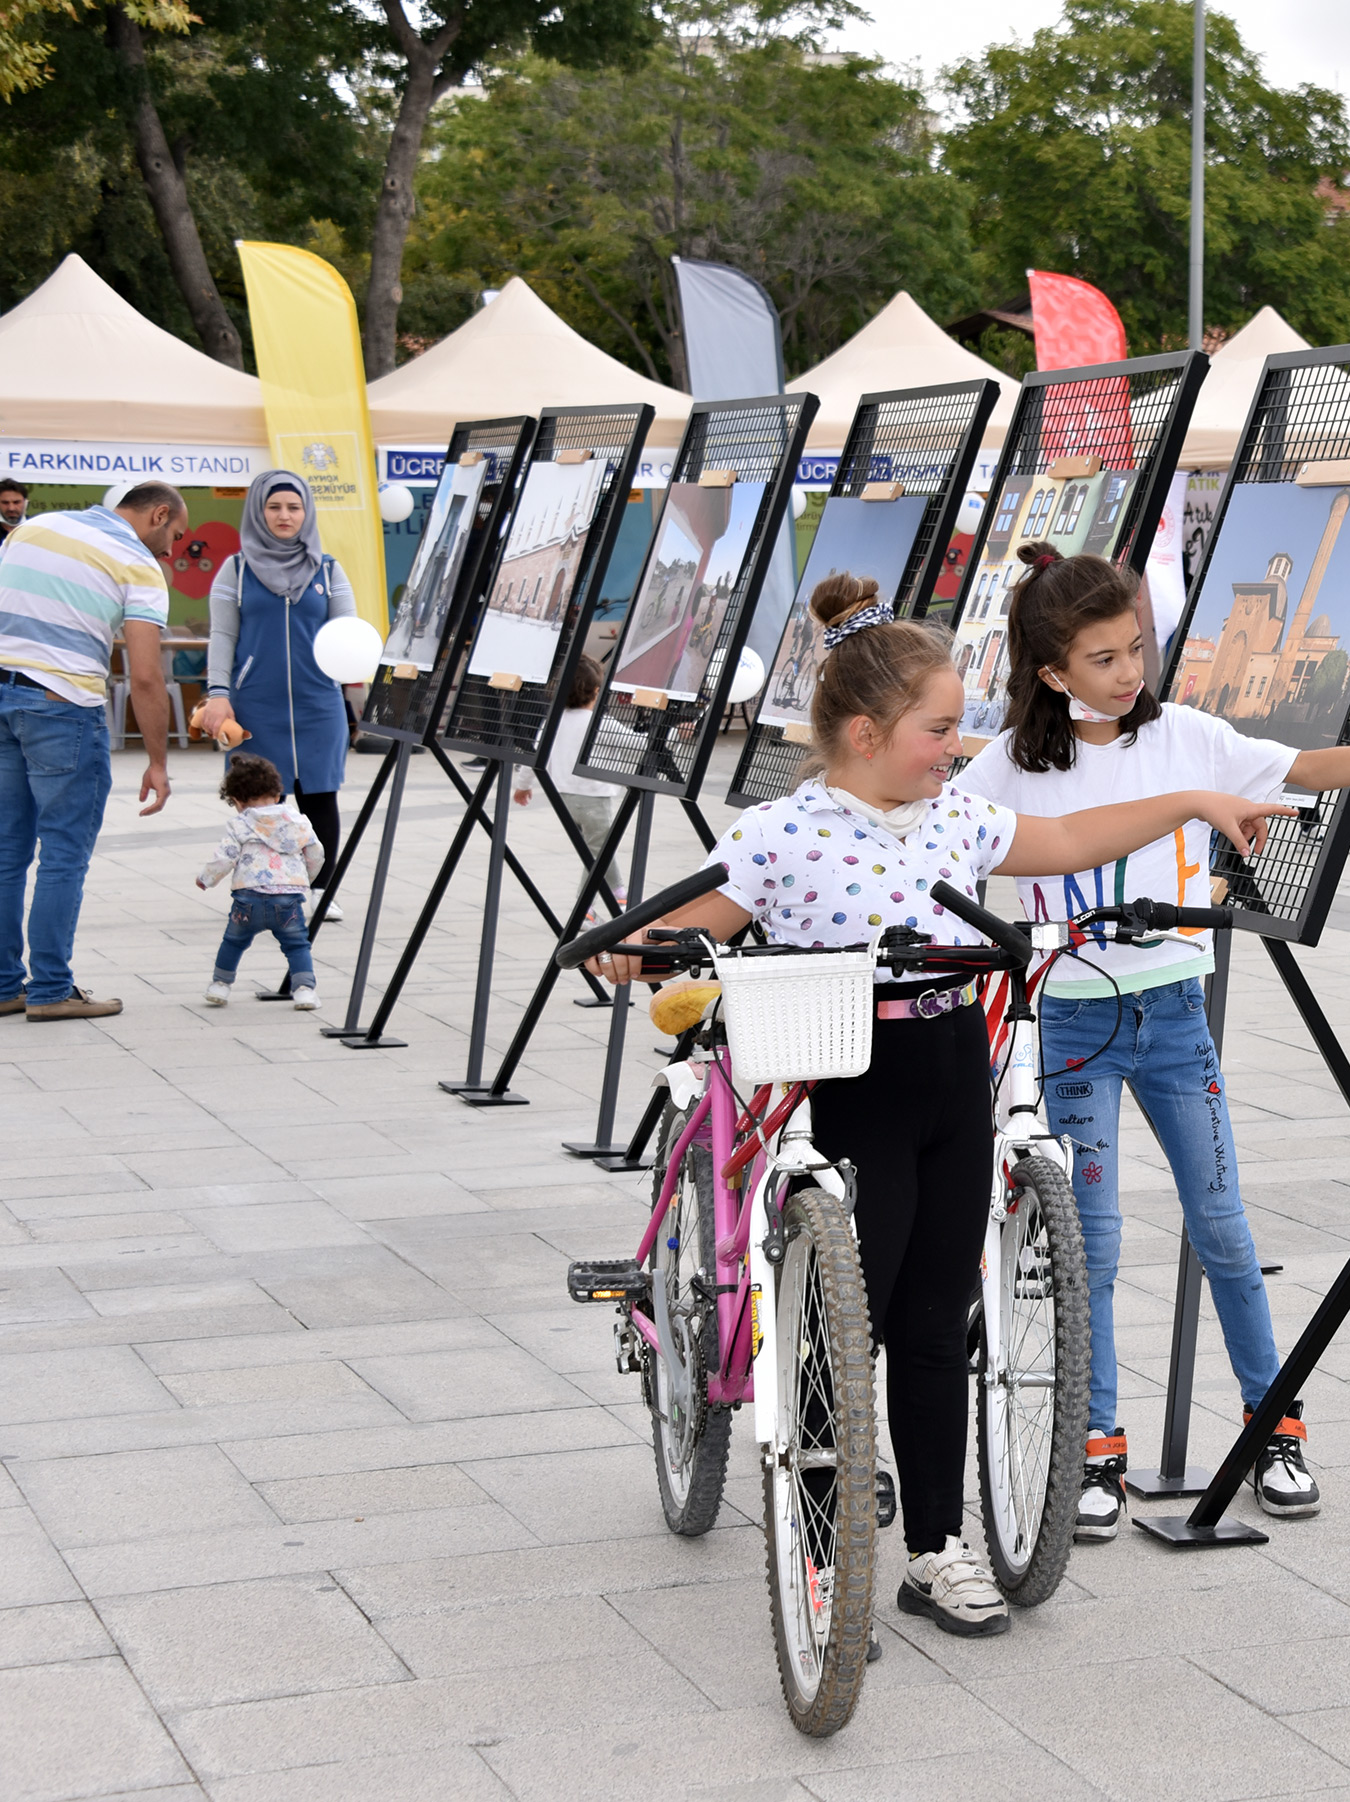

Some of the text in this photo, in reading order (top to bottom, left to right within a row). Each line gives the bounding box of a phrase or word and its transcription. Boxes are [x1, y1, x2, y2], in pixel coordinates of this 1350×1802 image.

[8, 451, 250, 474] FARKINDALIK STANDI
[1187, 479, 1220, 492] ATIK
[1059, 1085, 1090, 1096] THINK
